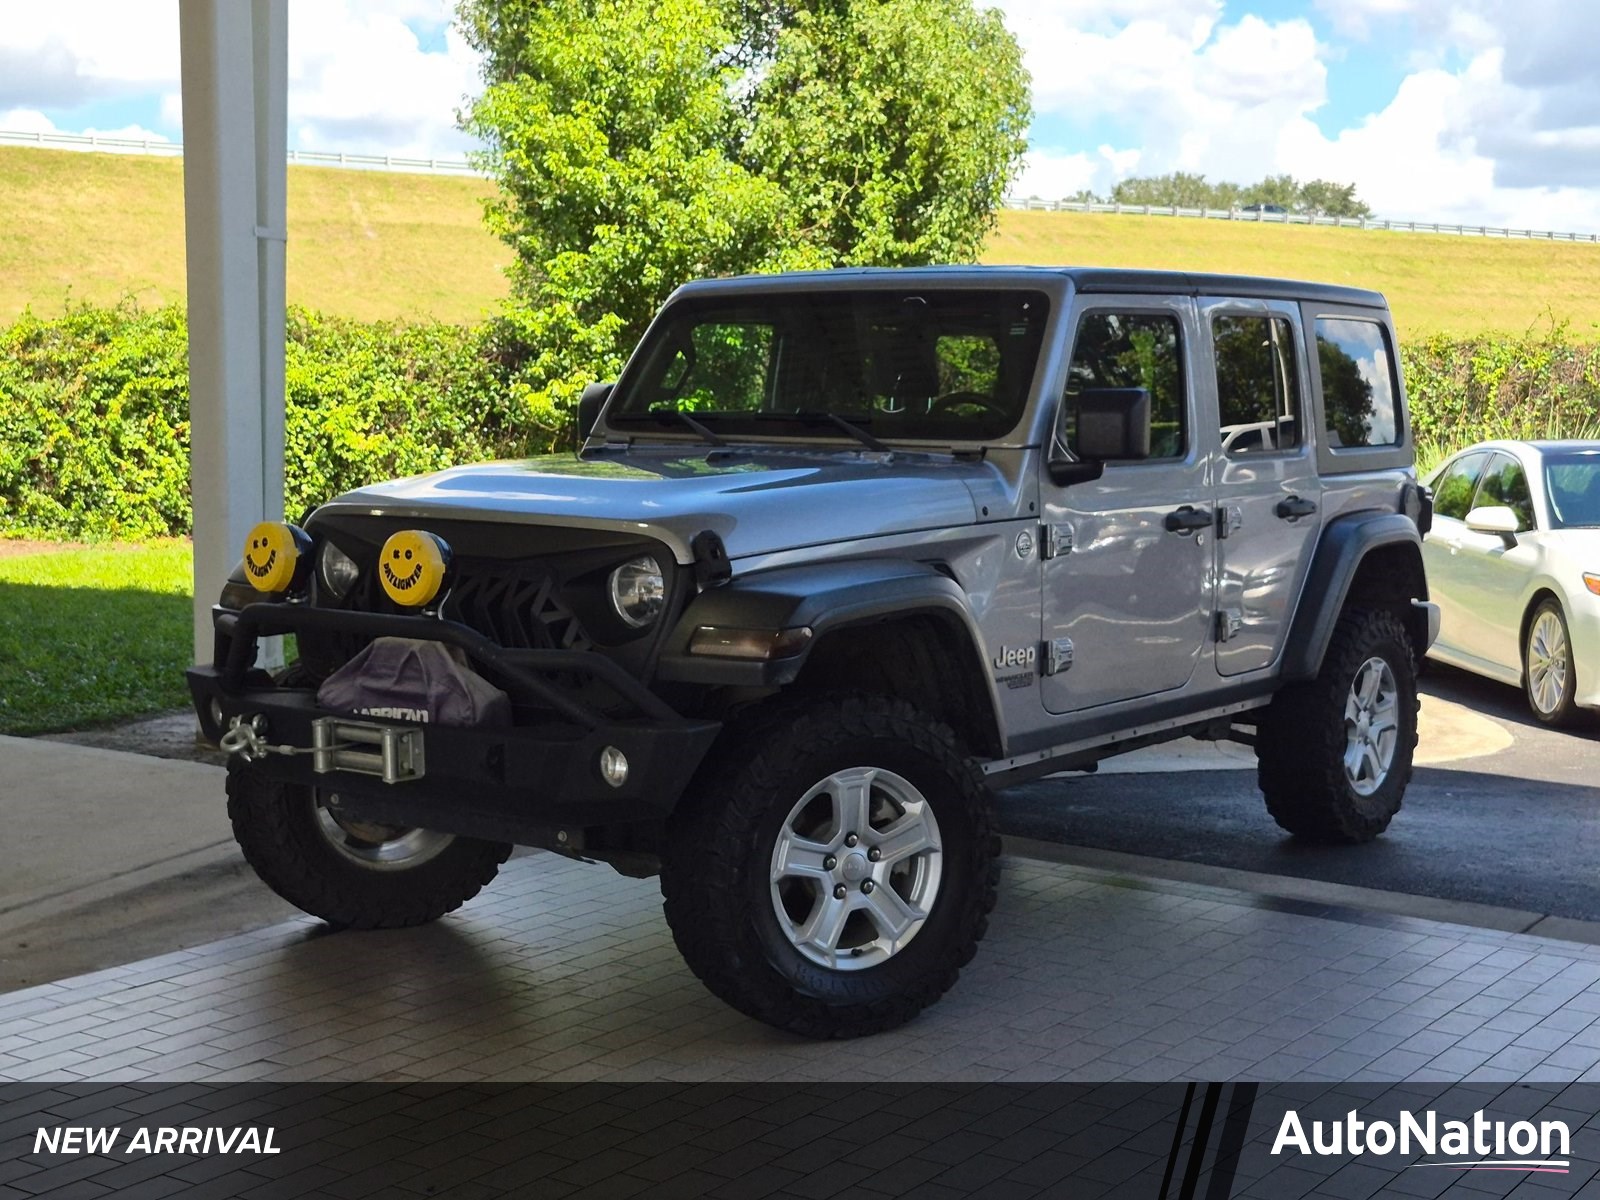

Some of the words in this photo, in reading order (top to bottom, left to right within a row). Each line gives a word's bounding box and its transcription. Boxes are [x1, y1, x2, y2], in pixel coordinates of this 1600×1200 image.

[246, 549, 276, 577] DAYLIGHTER
[383, 562, 422, 590] DAYLIGHTER
[994, 645, 1036, 668] Jeep
